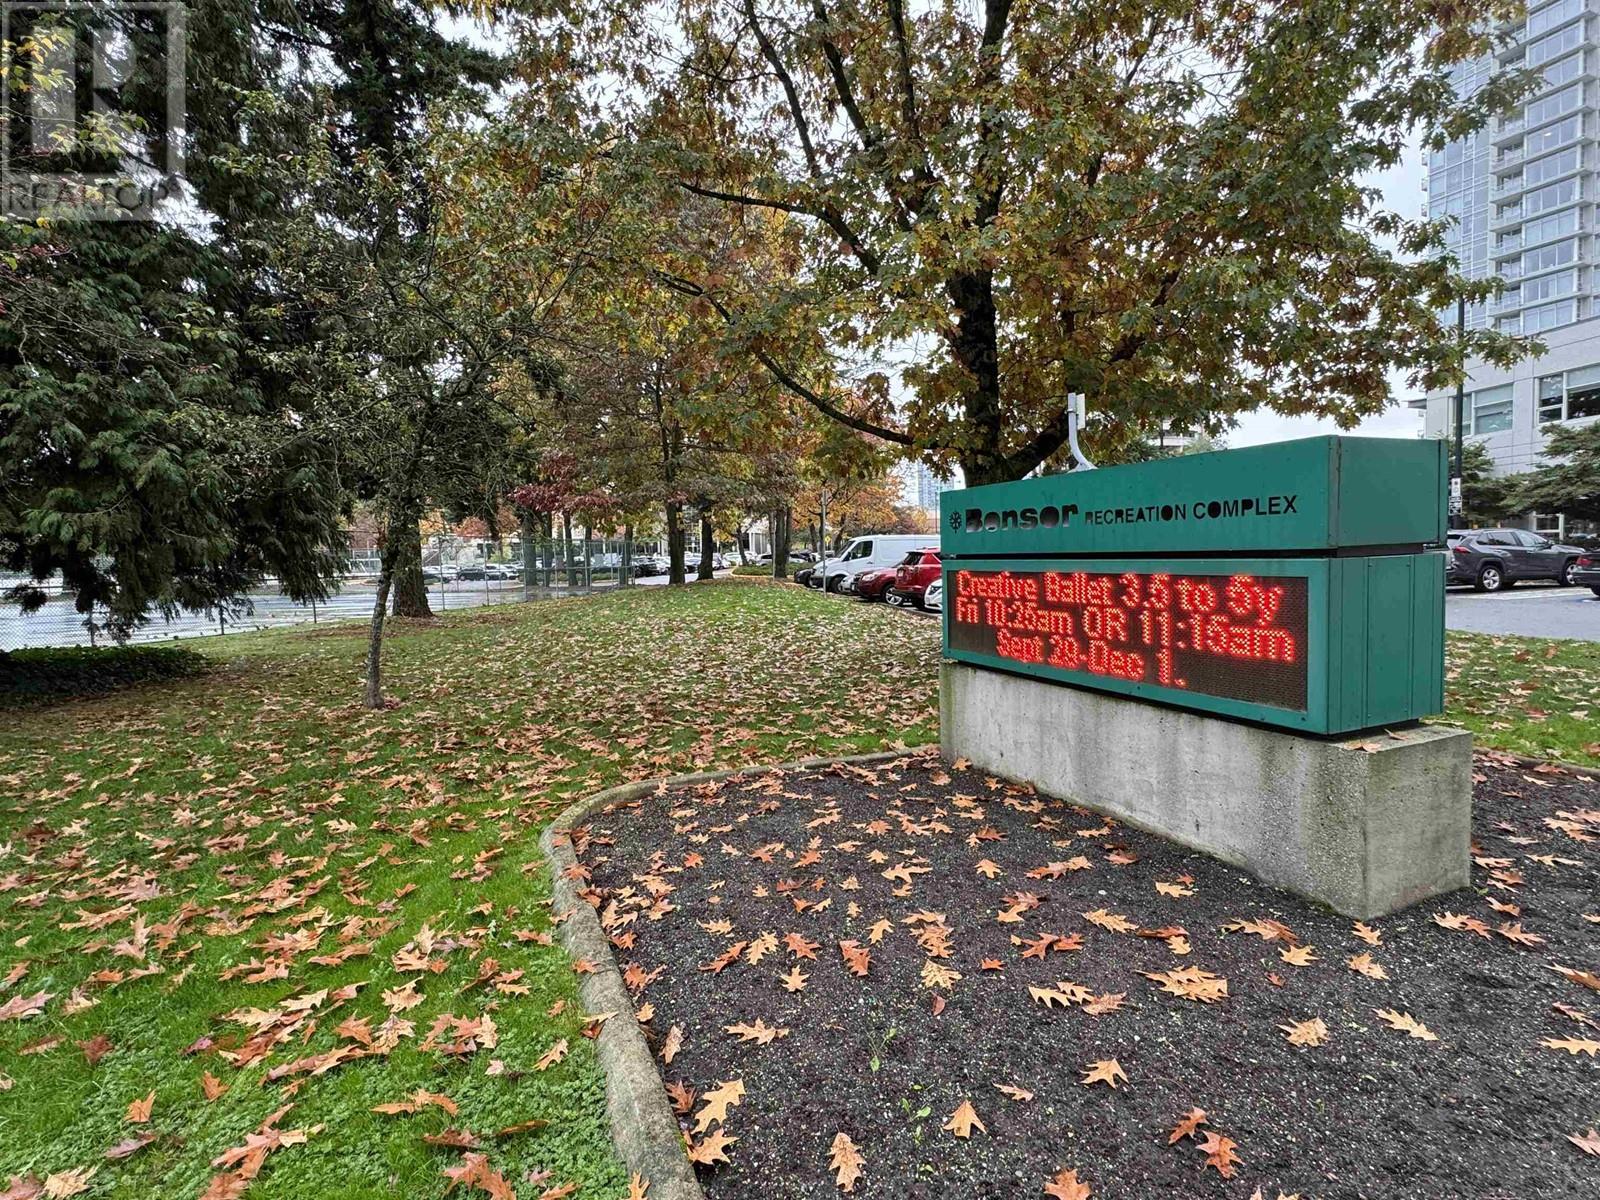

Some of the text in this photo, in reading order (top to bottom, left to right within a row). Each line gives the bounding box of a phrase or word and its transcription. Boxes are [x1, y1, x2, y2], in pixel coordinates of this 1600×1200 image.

[965, 495, 1298, 533] Bonsor RECREATION COMPLEX
[956, 569, 1283, 626] Creative Ballet 3.5 to 5y
[956, 598, 1294, 662] Fri 10:25am OR 11:15am
[996, 629, 1044, 663] Sept
